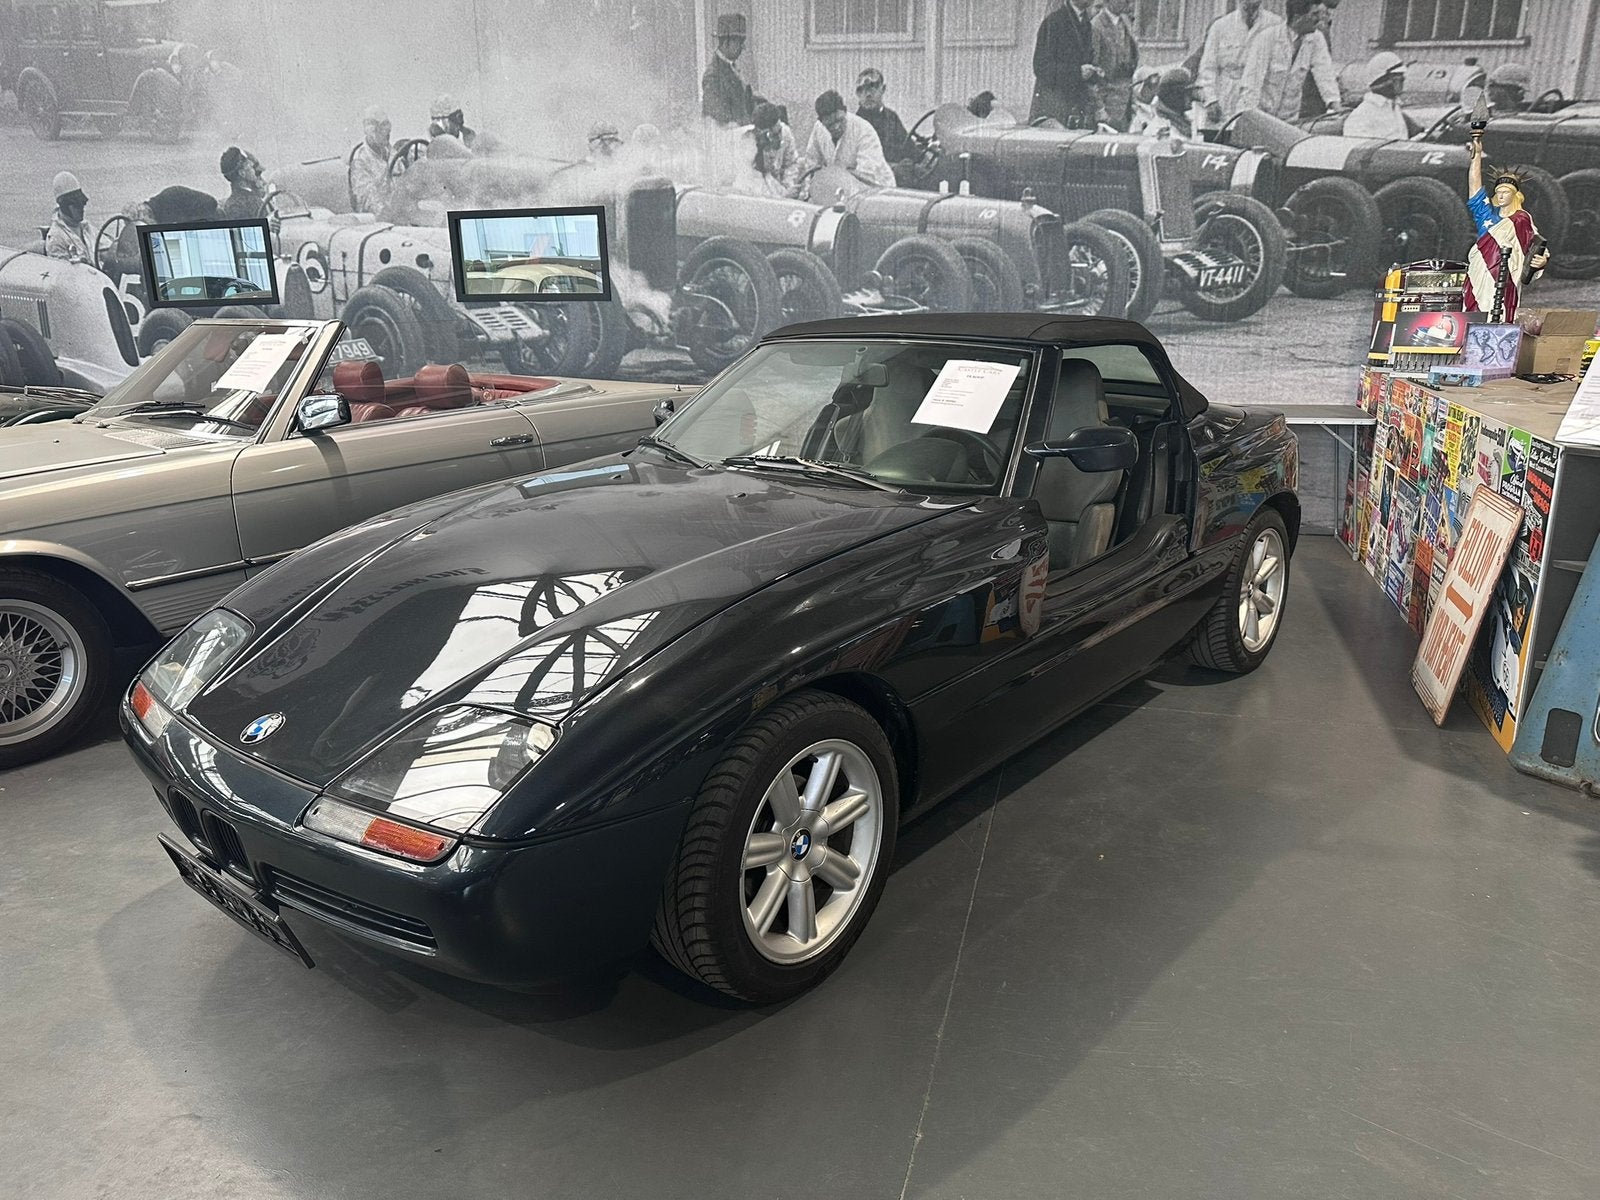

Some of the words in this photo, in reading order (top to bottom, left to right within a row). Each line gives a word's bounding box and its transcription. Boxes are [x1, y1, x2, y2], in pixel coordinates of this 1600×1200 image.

[1201, 154, 1229, 170] 14
[1421, 151, 1446, 165] 12
[978, 208, 998, 220] 10
[298, 241, 327, 293] 6
[119, 273, 146, 336] 5
[1454, 517, 1503, 594] FOLLOW
[1422, 605, 1451, 670] YOUR
[1432, 619, 1467, 689] HEART
